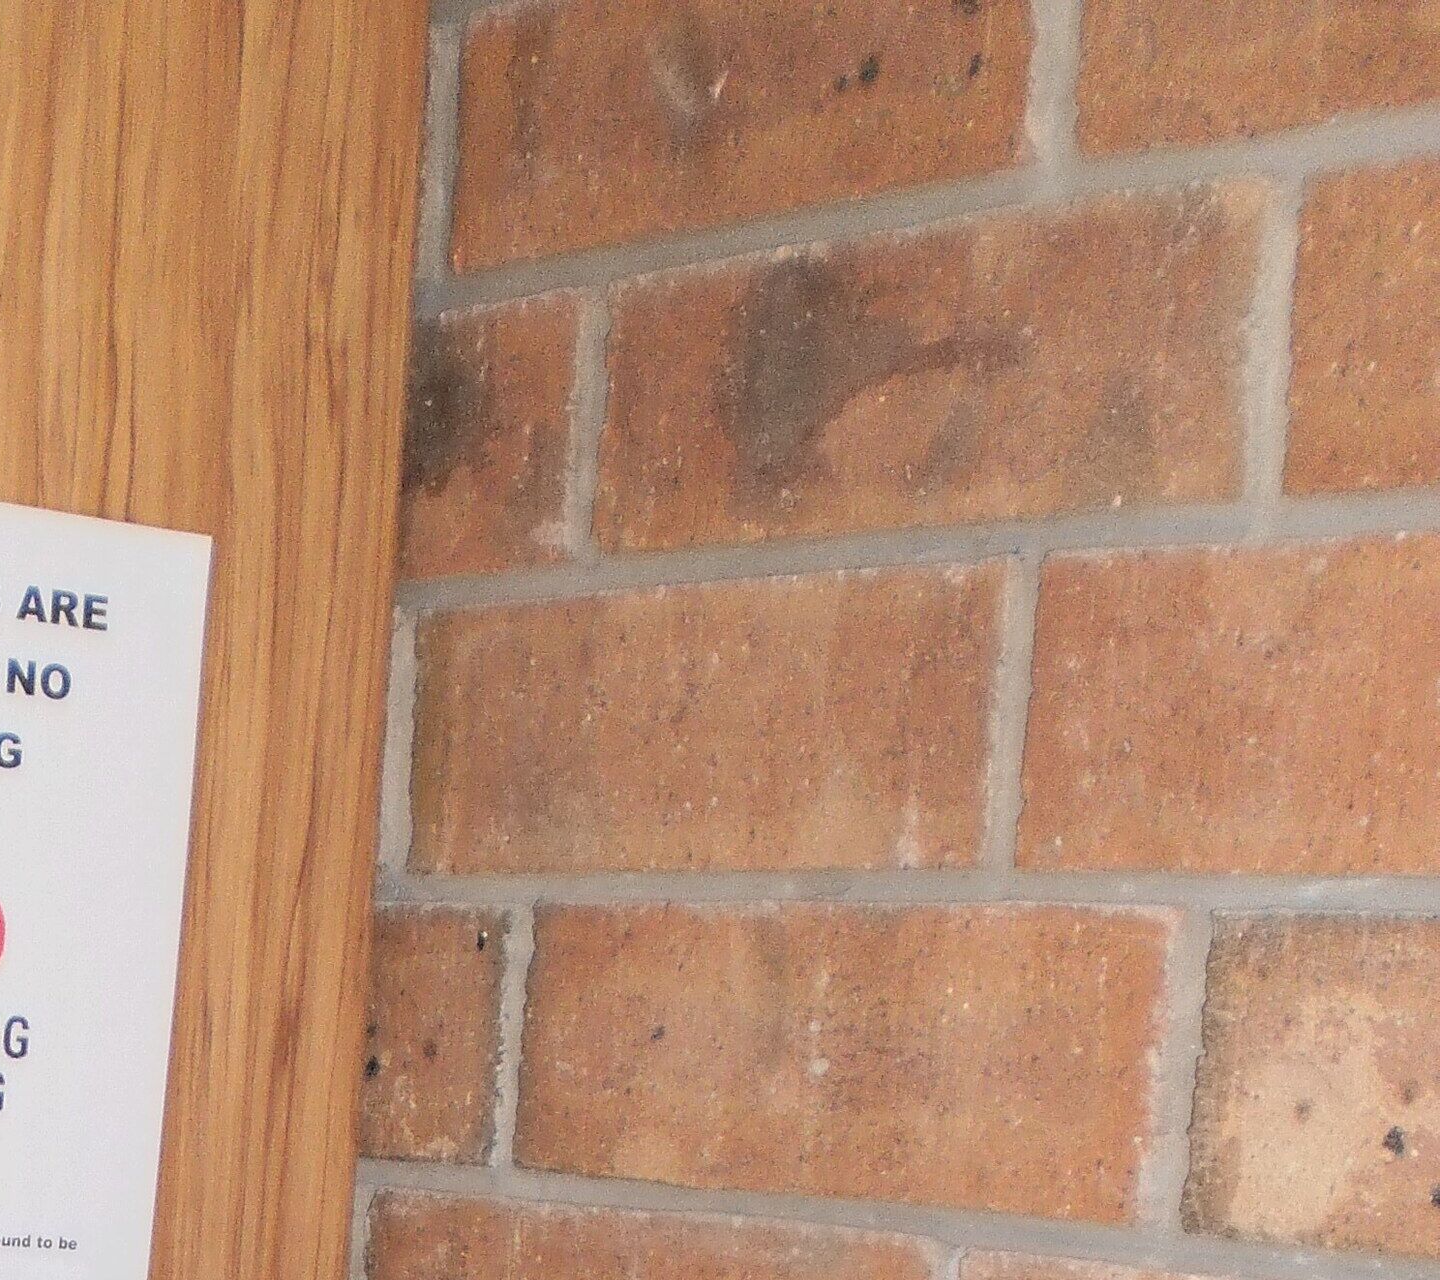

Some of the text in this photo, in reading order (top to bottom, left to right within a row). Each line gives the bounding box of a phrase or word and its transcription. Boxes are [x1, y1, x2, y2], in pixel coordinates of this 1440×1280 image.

[16, 586, 109, 631] ARE
[5, 658, 72, 700] NO
[37, 1235, 53, 1250] to
[58, 1236, 77, 1251] be
